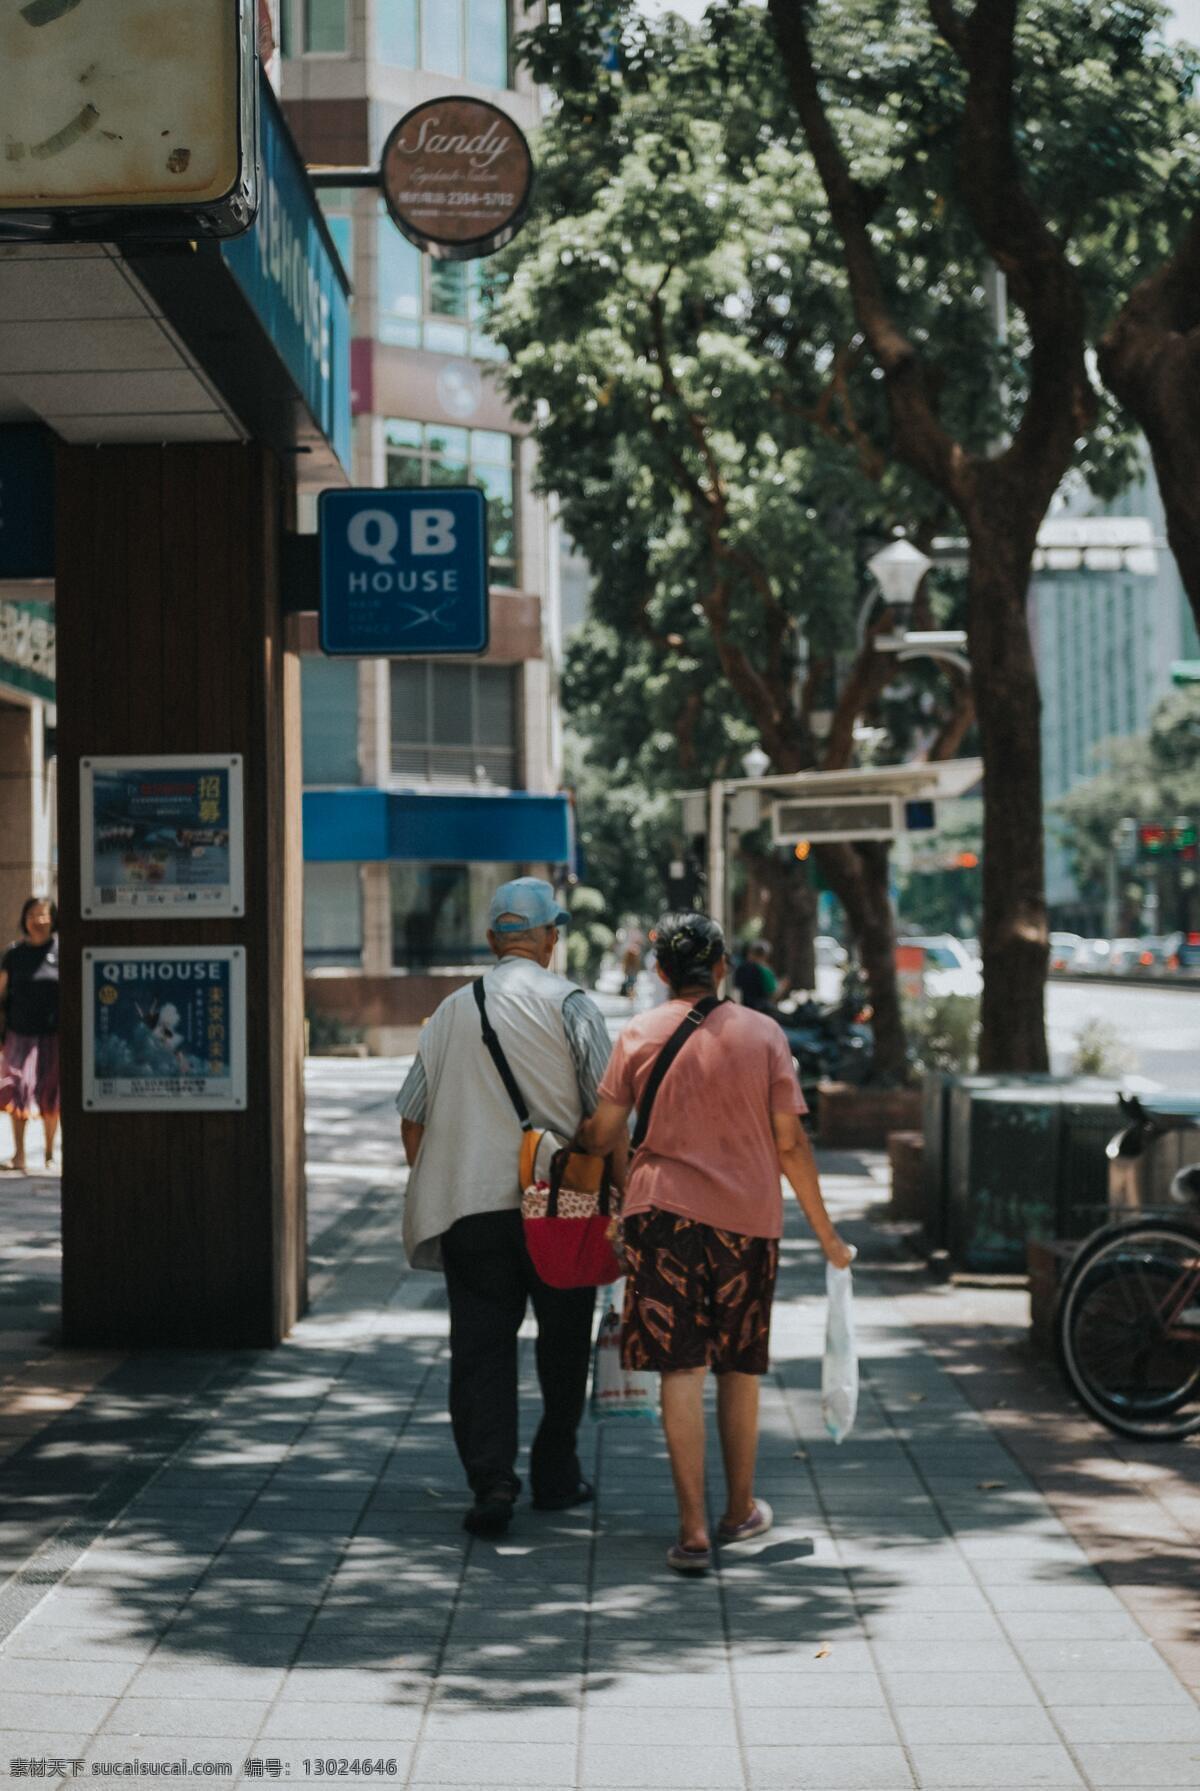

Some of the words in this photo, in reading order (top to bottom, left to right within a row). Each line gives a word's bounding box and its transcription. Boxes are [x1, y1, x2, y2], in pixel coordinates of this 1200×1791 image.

[398, 118, 510, 167] Sandy
[347, 508, 457, 565] QB
[348, 570, 457, 592] HOUSE
